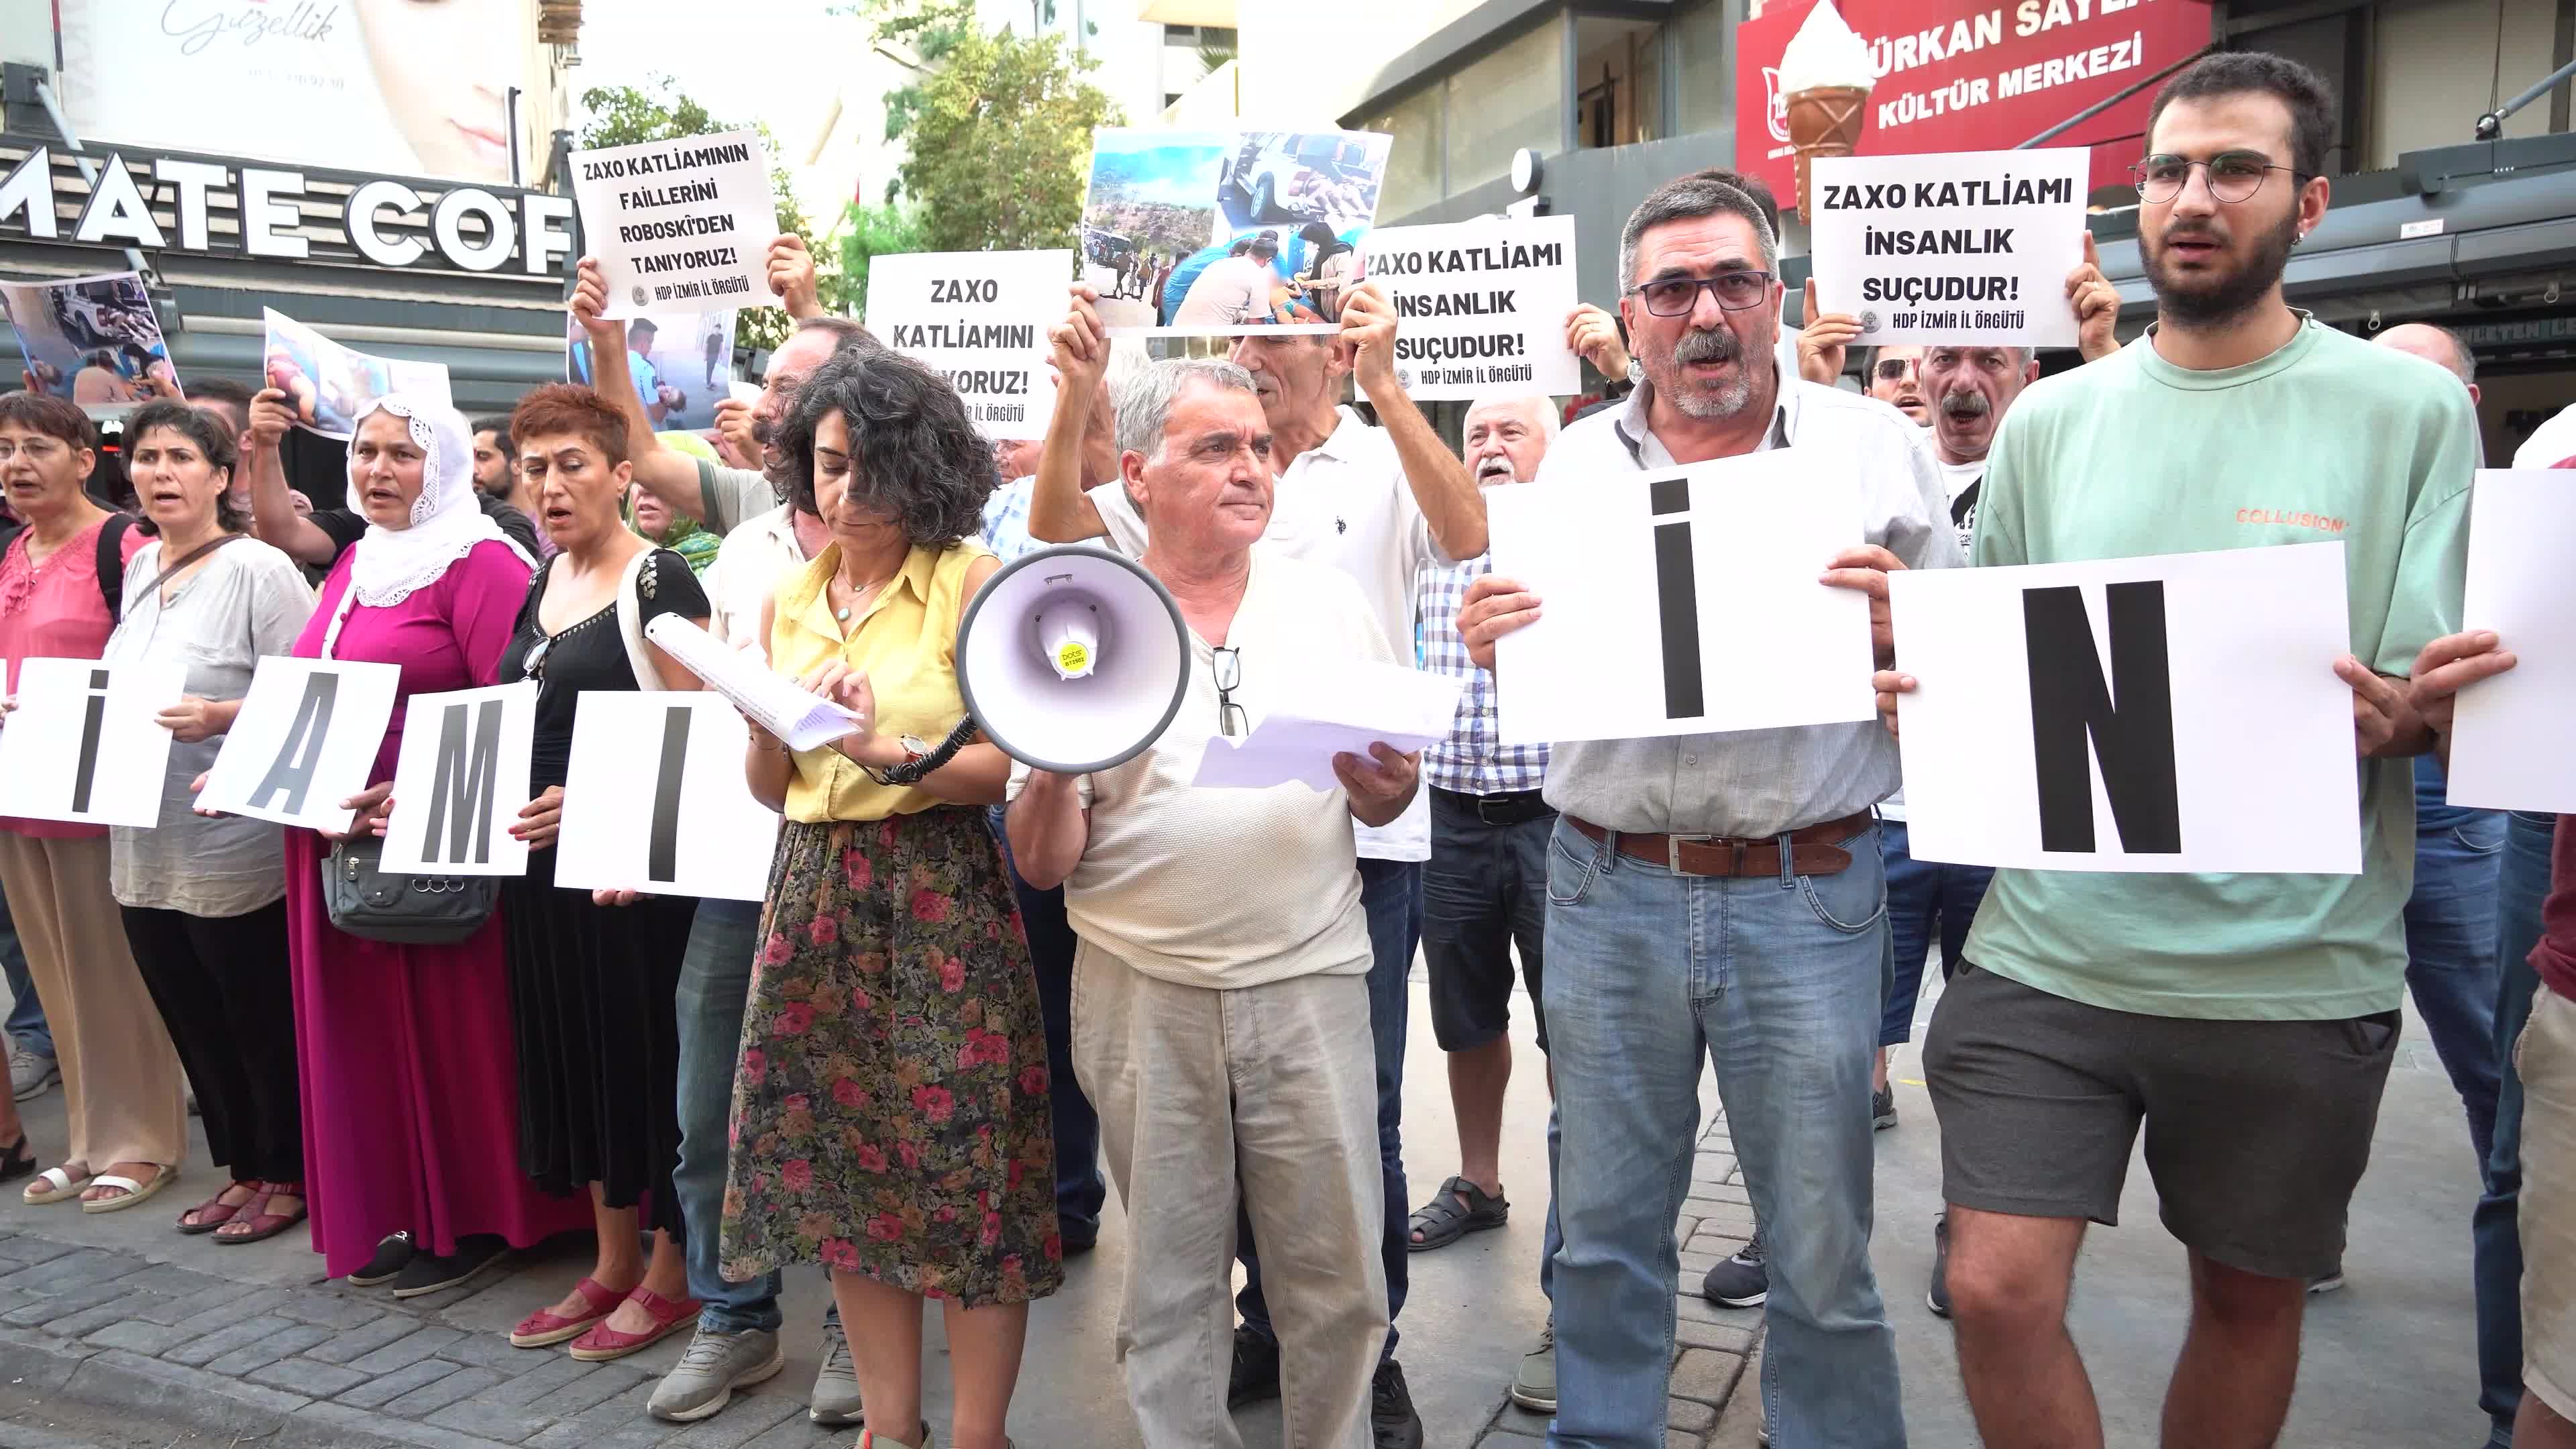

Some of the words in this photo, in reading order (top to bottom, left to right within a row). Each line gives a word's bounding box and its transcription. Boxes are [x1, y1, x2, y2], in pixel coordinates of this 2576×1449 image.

[1868, 9, 2002, 78] ÜRKAN
[1878, 77, 1990, 129] KÜLTÜR
[1998, 30, 2142, 99] MERKEZİ
[583, 160, 625, 181] ZAXO
[626, 143, 750, 176] KATLİAMININ
[619, 177, 718, 210] FAİLLERİNİ
[1824, 184, 1907, 209] ZAXO
[1914, 173, 2072, 208] KATLİAMI
[1865, 225, 2015, 256] İNSANLIK
[631, 247, 738, 274] TANIYORUZ!
[1428, 240, 1562, 274] KATLİAMI
[654, 284, 672, 301] HDP
[672, 279, 701, 299] İZMİR
[700, 279, 712, 297] İL
[710, 275, 750, 295] ÖRGÜTÜ
[930, 279, 998, 303] ZAXO
[1393, 290, 1517, 317] İNSANLIK
[1862, 276, 2019, 307] SUÇUDUR!
[893, 319, 1034, 349] KATLİAMINI
[1892, 313, 1917, 329] HDP
[1921, 310, 1957, 329] İZMİR
[1960, 310, 1972, 329] İL
[1975, 310, 2025, 329] ÖRGÜTÜ
[1395, 333, 1525, 364] SUÇUDUR!
[934, 370, 1028, 394] YORUZ!
[1421, 370, 1440, 385] HDP
[1442, 367, 1474, 385] İZMİR
[1476, 367, 1487, 384] İL
[1489, 364, 1532, 383] ÖRGÜTÜ
[975, 403, 983, 421] İL
[986, 403, 1024, 422] ÖRGÜTÜ
[2235, 506, 2345, 533] COLLUSION
[2022, 580, 2182, 854] N
[247, 672, 339, 816] A
[421, 699, 503, 865] M
